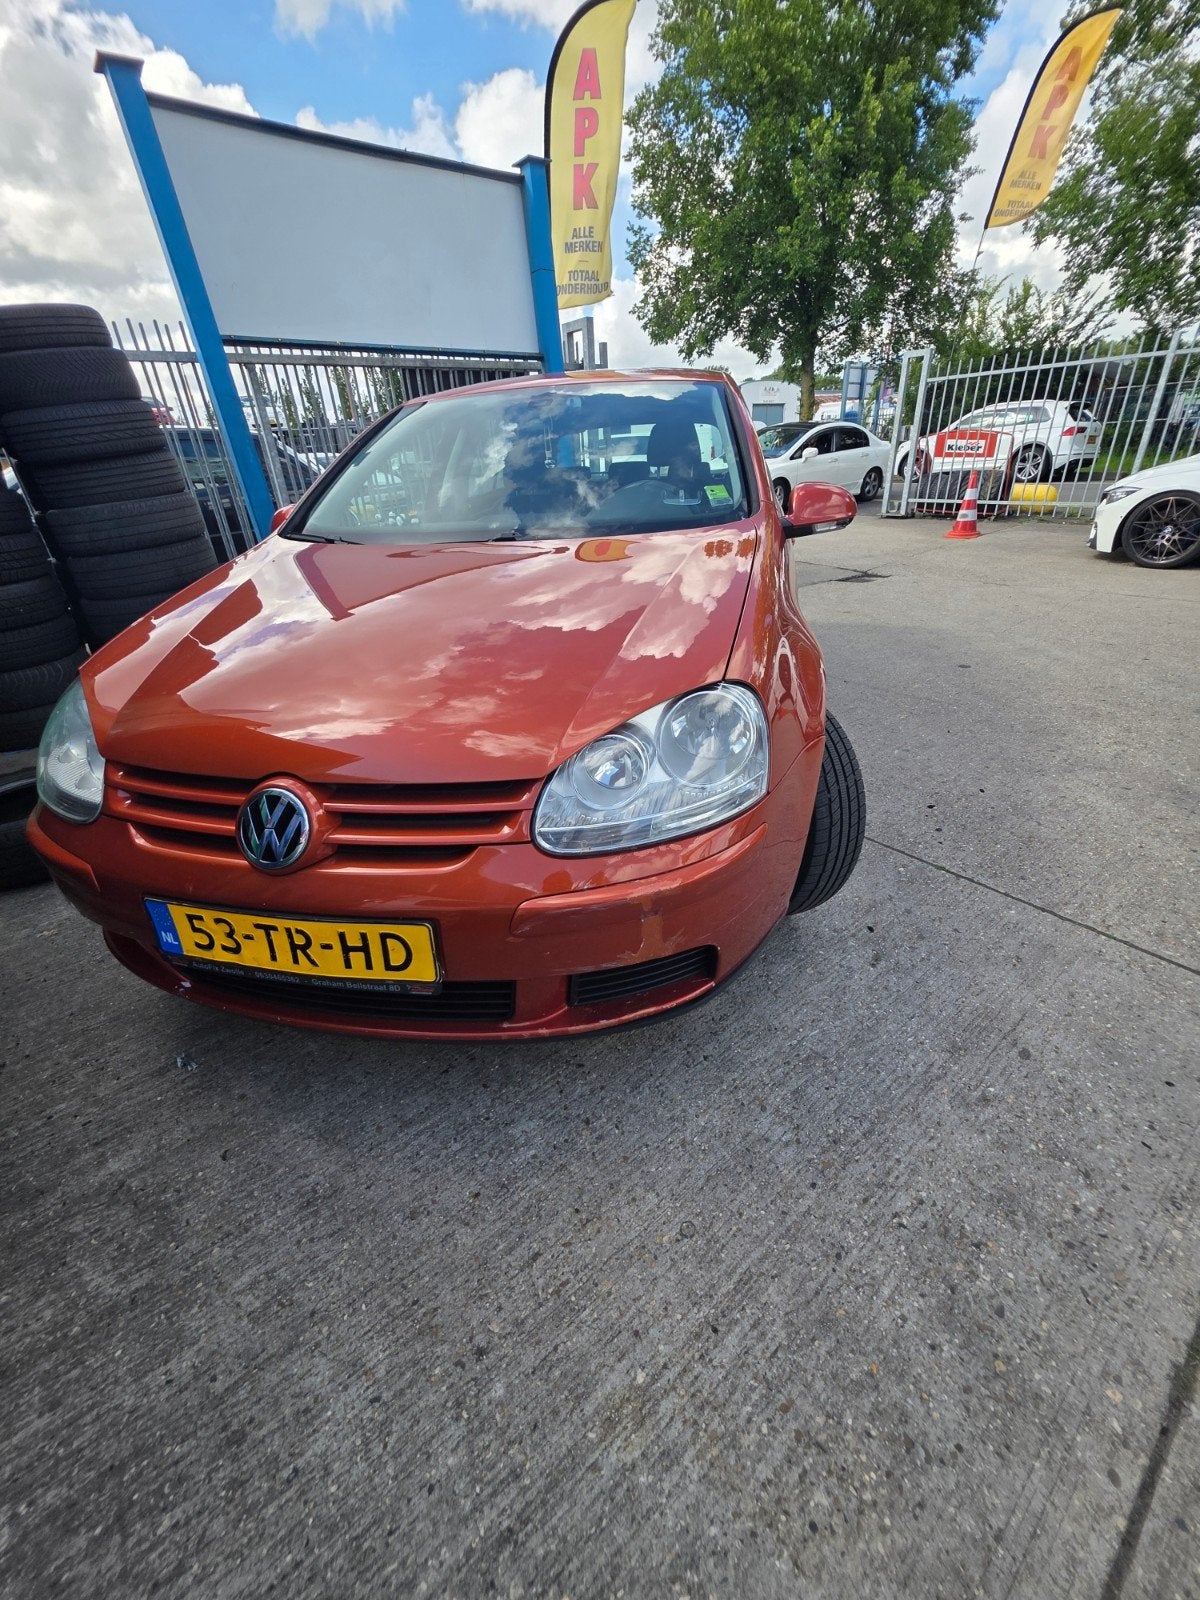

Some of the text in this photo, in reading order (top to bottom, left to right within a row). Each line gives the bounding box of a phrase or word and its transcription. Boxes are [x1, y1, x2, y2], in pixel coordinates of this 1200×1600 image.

[573, 48, 601, 210] APK
[1009, 179, 1042, 190] MERKEN
[571, 226, 595, 240] ALLE
[564, 240, 603, 254] MERKEN
[567, 269, 600, 282] TOTAAL
[556, 281, 609, 296] ONDERHOUD
[947, 444, 982, 452] Kleber
[161, 930, 179, 945] NL
[185, 912, 413, 973] 53-TR-HD
